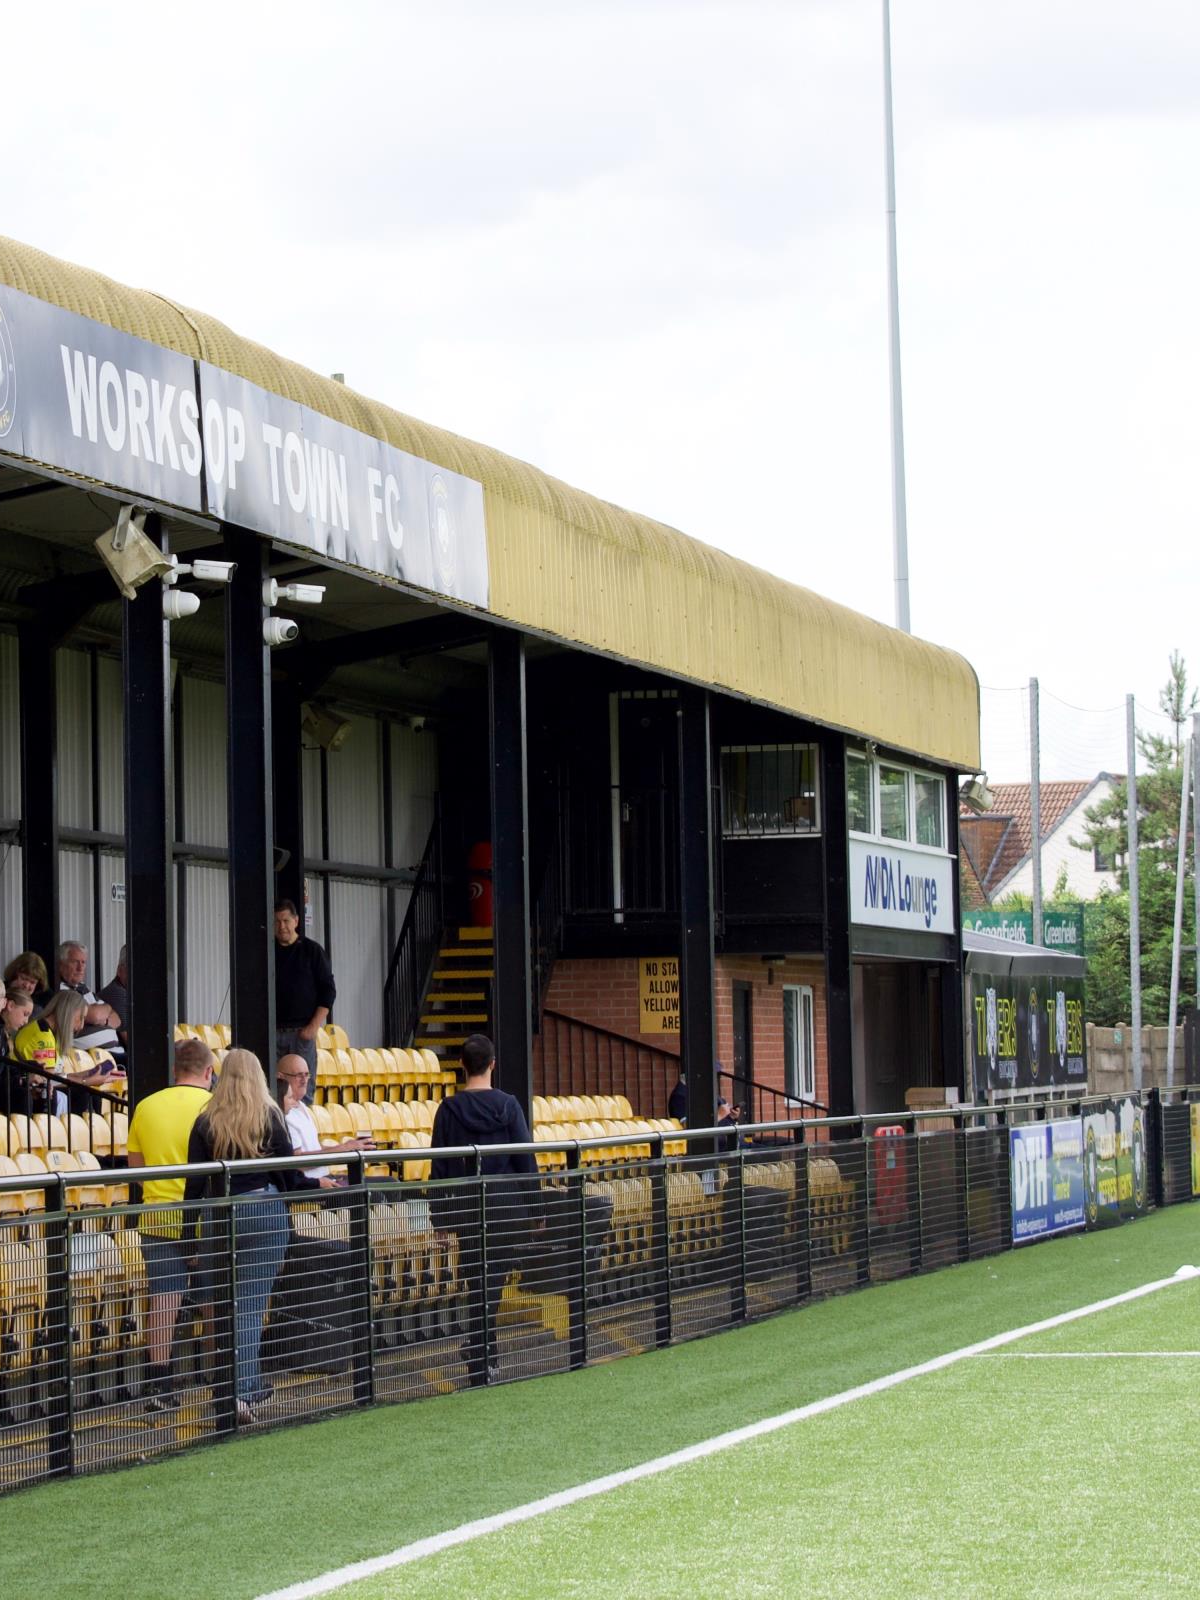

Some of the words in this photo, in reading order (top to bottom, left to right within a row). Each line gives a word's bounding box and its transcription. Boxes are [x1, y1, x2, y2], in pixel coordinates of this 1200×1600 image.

[60, 343, 246, 491] WORKSOP
[262, 422, 349, 532] TOWN
[367, 466, 404, 550] FC
[898, 860, 937, 929] Lounge
[646, 962, 658, 976] NO
[662, 962, 678, 976] STA
[649, 980, 679, 994] ALLOW
[644, 998, 679, 1012] YELLOW
[662, 1016, 680, 1030] ARE
[1014, 1135, 1048, 1211] DTH
